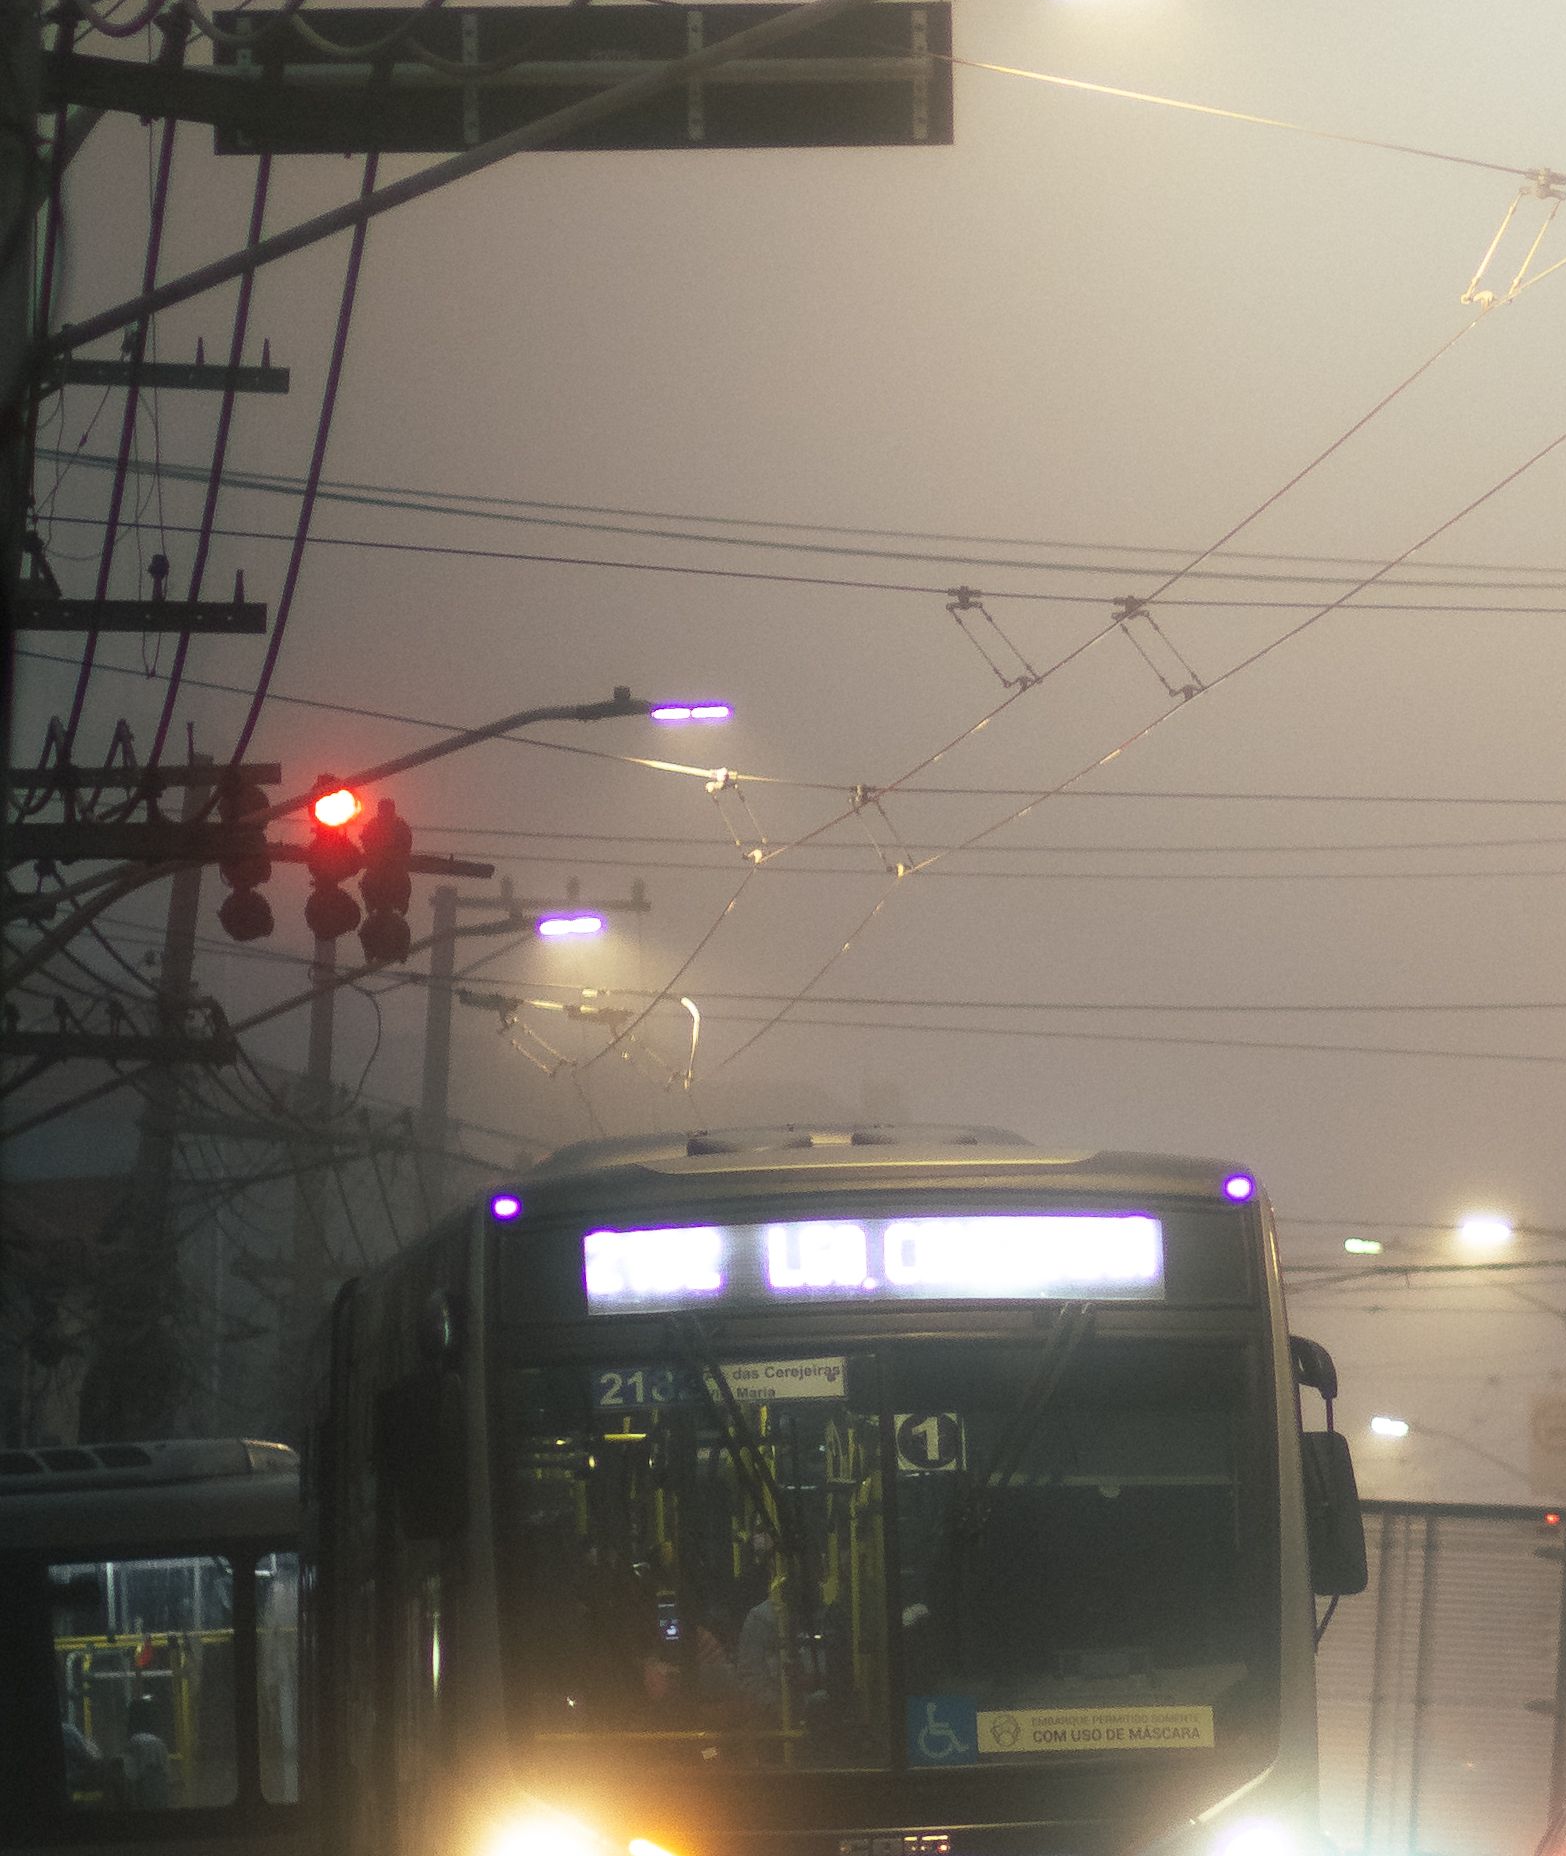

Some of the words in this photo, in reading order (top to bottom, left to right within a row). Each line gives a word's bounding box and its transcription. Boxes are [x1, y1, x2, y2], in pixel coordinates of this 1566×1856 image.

[911, 1416, 939, 1460] 1
[1032, 1729, 1067, 1743] COM
[1070, 1728, 1102, 1742] USO
[1106, 1727, 1126, 1741] DE
[1129, 1724, 1201, 1740] MÁSCARA
